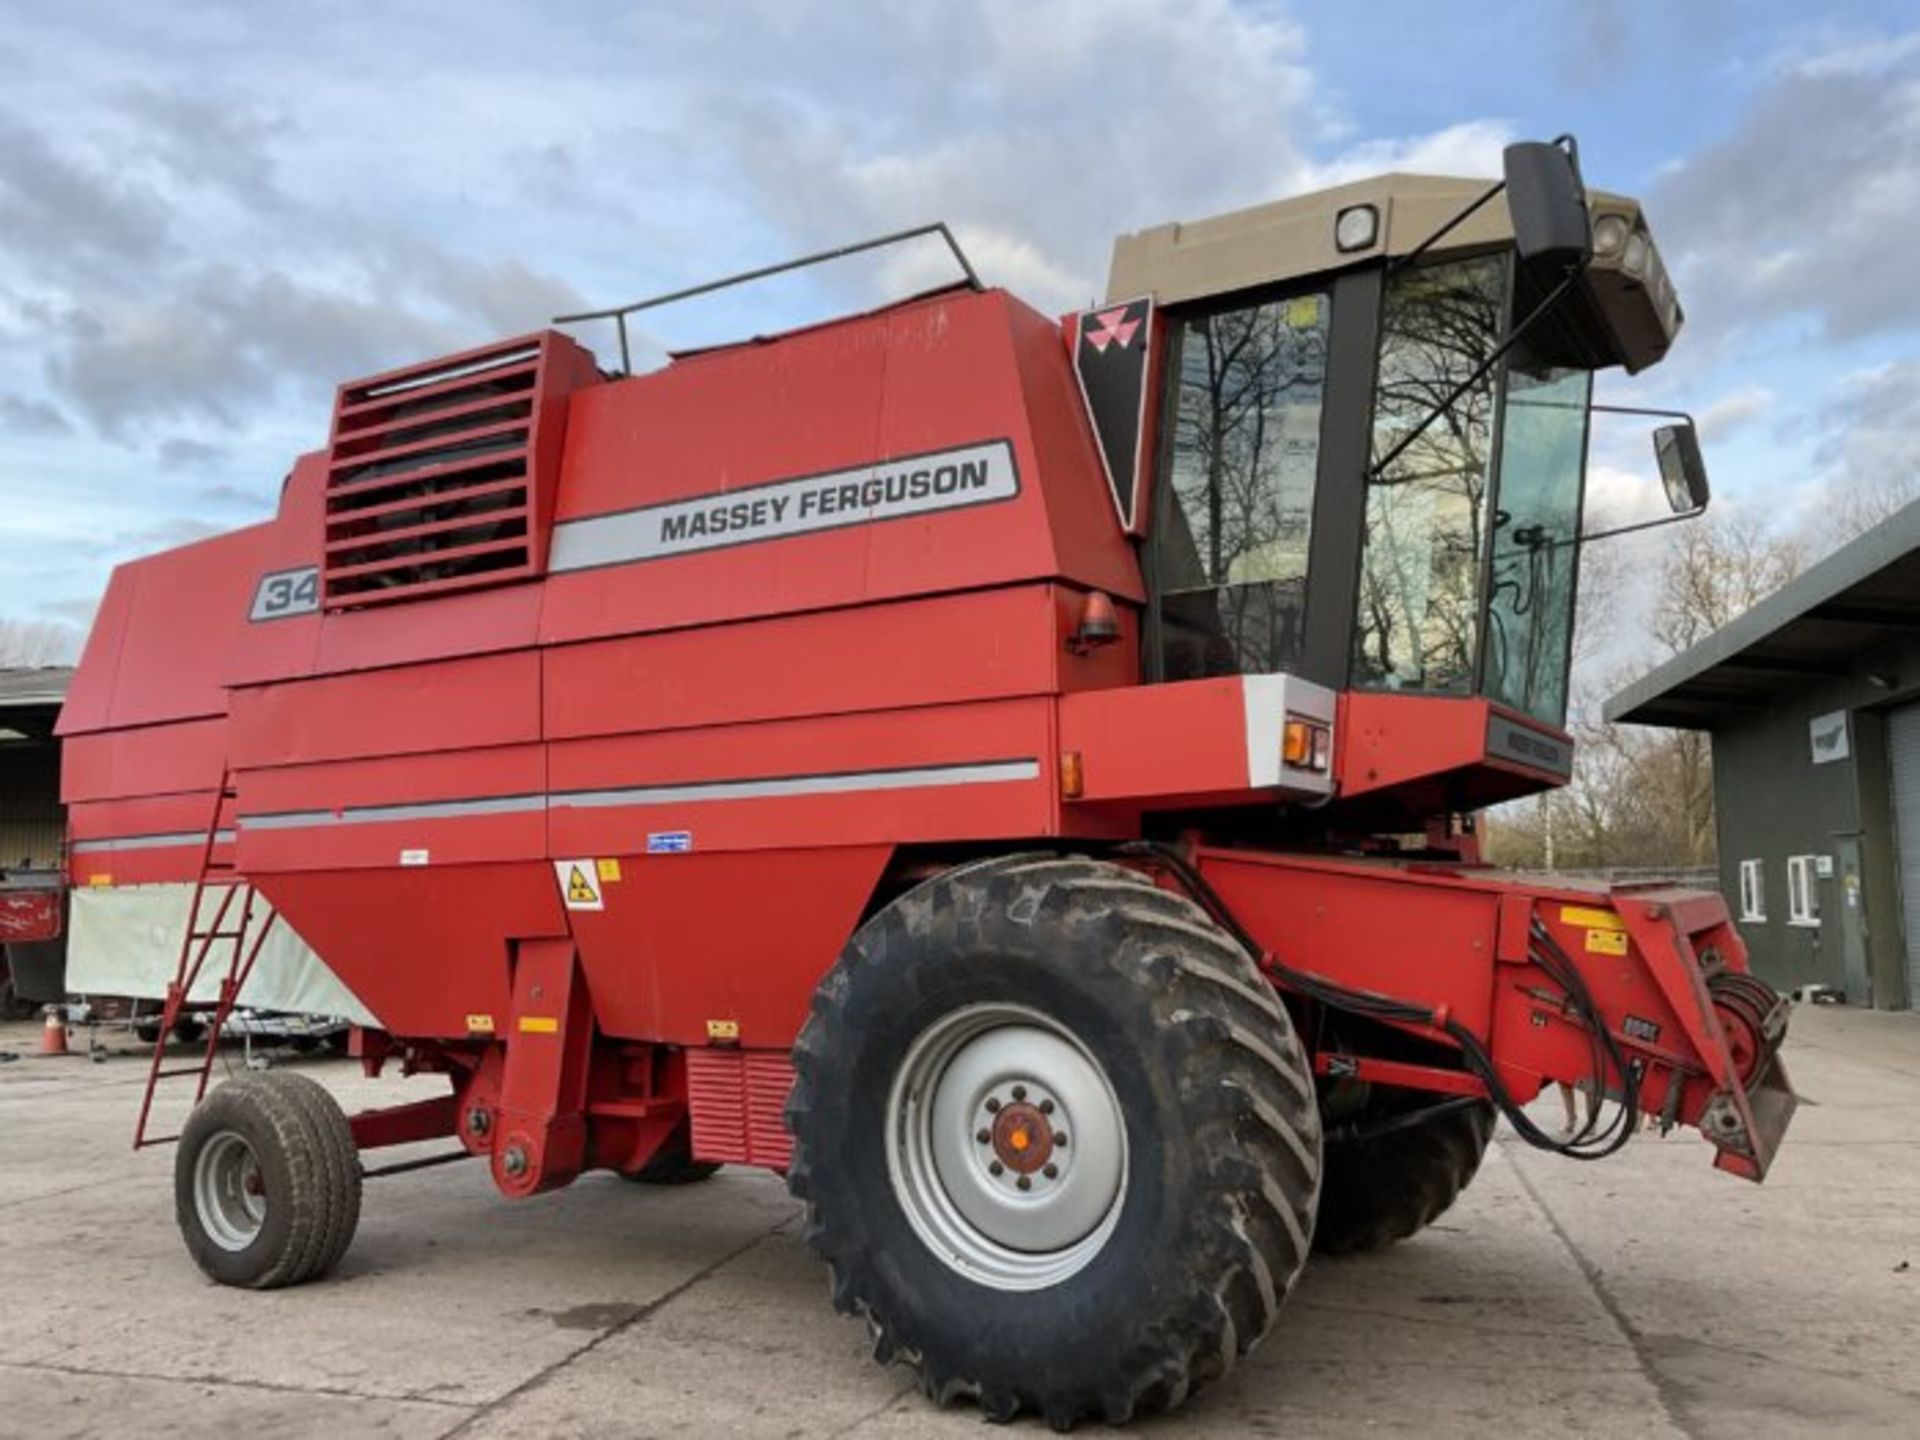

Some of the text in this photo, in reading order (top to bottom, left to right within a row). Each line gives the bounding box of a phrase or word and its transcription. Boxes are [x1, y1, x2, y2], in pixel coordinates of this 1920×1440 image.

[661, 460, 988, 543] MASSEY FERGUSON
[265, 573, 317, 613] 34
